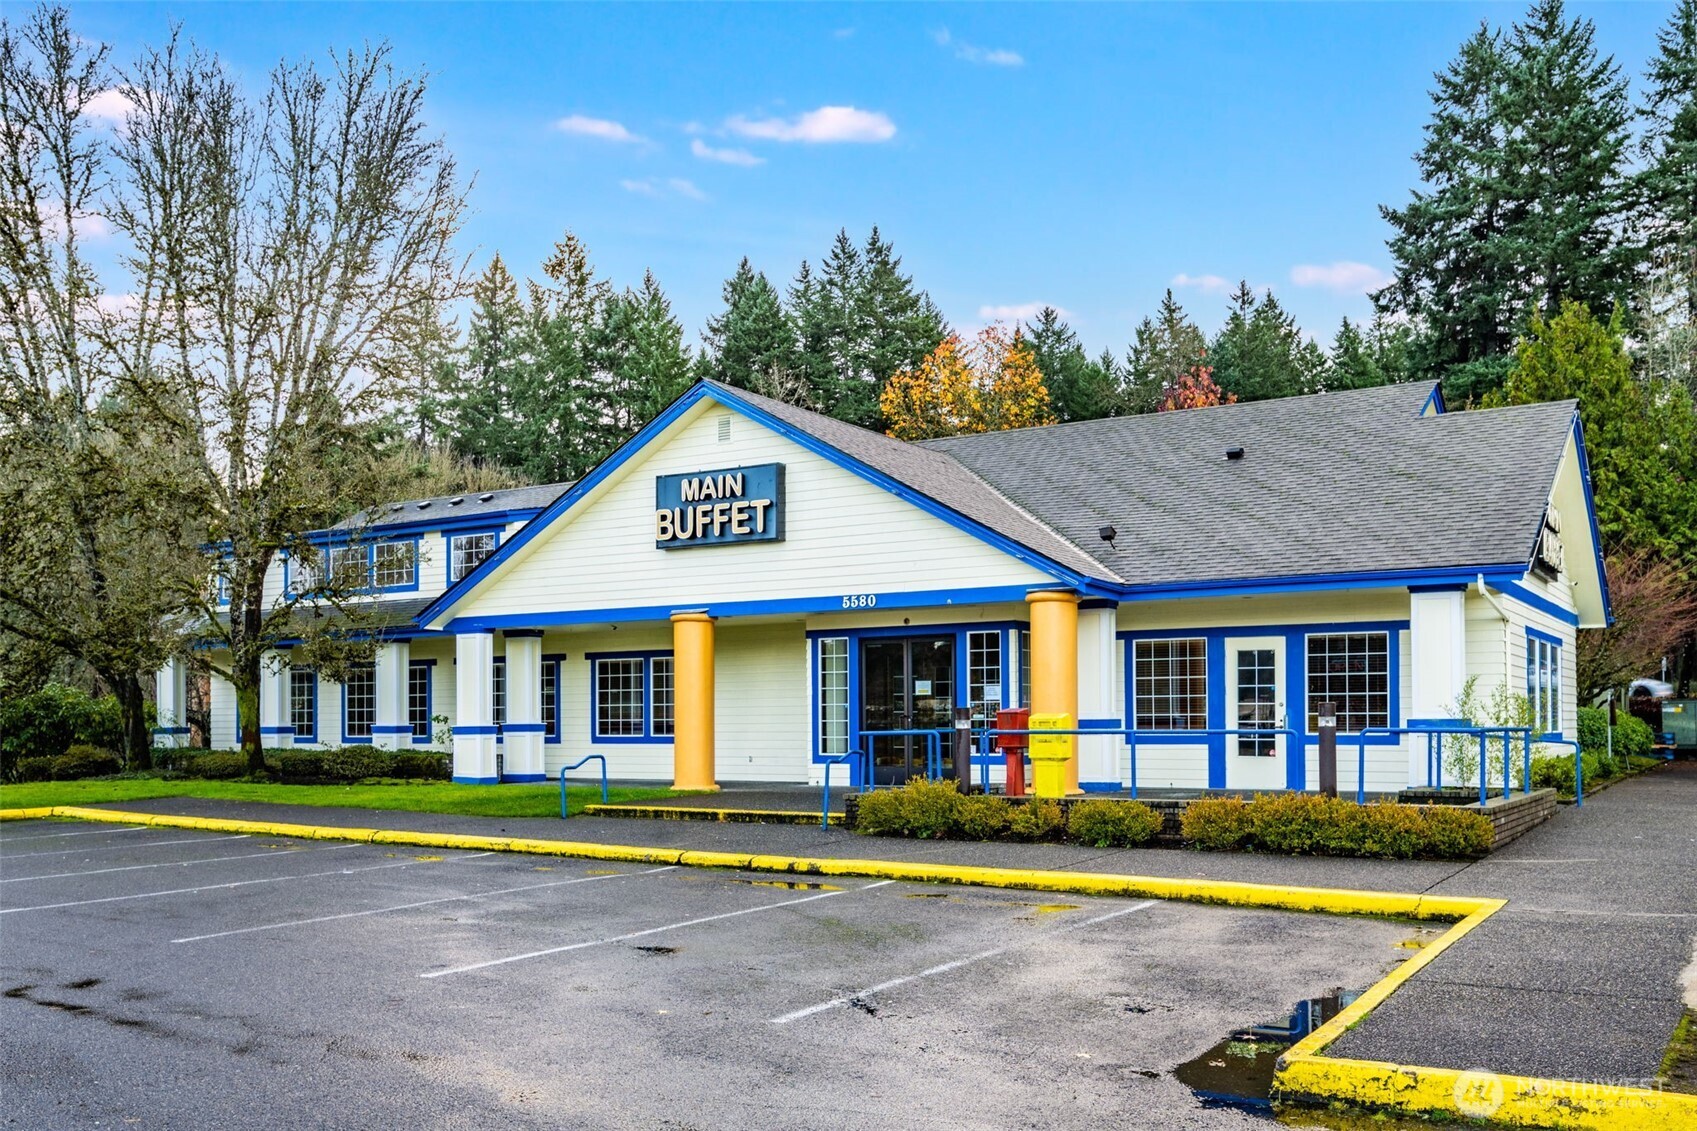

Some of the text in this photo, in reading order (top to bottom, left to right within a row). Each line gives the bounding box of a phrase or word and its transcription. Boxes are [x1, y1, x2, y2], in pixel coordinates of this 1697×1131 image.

[681, 472, 743, 502] MAIN
[656, 499, 771, 540] BUFFET
[842, 594, 877, 608] 5580
